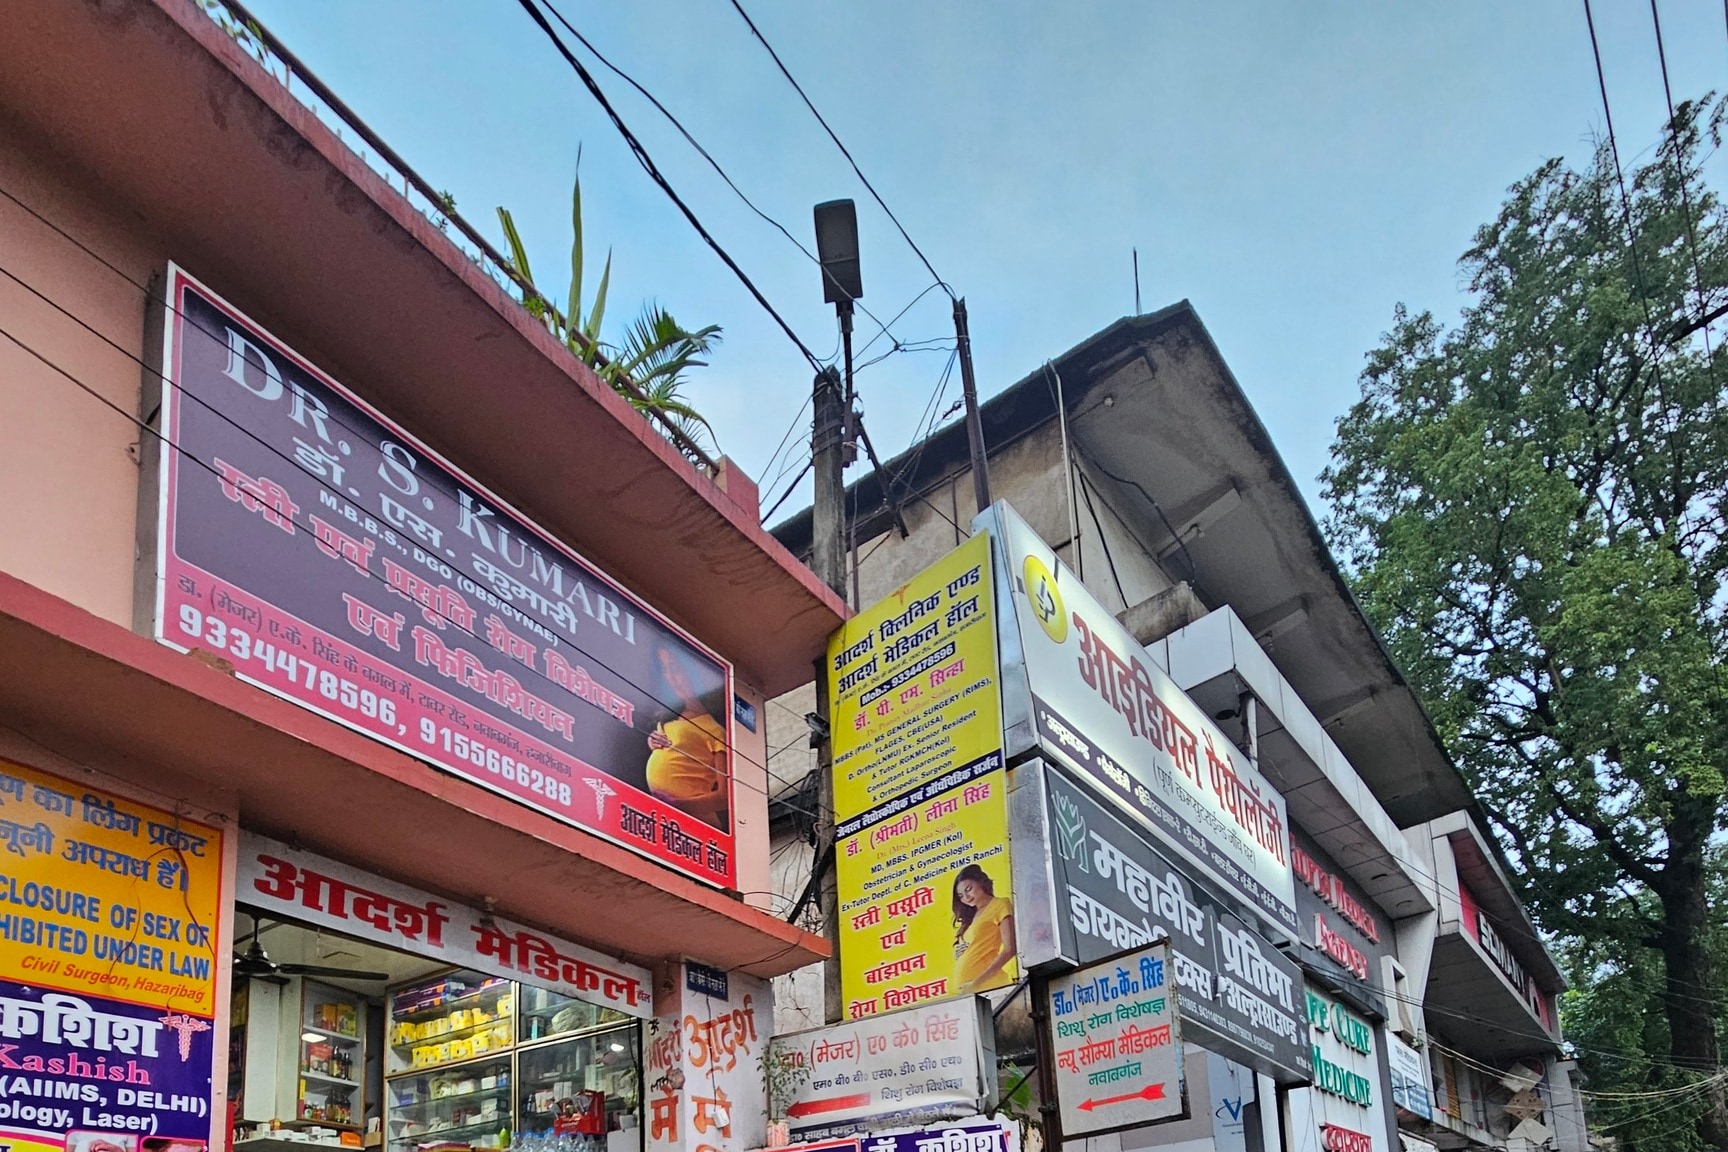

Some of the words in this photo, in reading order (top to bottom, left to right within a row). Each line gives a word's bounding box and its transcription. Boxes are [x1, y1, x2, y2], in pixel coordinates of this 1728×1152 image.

[221, 326, 351, 455] DR.
[378, 440, 434, 510] S.
[456, 488, 636, 645] KUMARI
[292, 437, 360, 497] डॉ.
[379, 492, 455, 557] एस.
[472, 553, 578, 634] कुमारी
[309, 513, 375, 577] एवं
[382, 557, 477, 638] प्रसूति
[484, 614, 537, 670] रोग
[320, 489, 408, 556] M.B.B.S.,
[413, 547, 452, 579] DGO
[457, 575, 559, 646] (OBS/GYNAE)
[342, 593, 405, 652] एवं
[411, 625, 575, 742] फिजिशियन
[834, 629, 874, 671] आदर्श
[838, 654, 878, 695] आदर्श
[883, 618, 940, 664] मेडिकल
[891, 644, 954, 688] 9334478596
[179, 604, 406, 736] 9334478596,
[420, 717, 571, 807] 9155666288
[887, 715, 922, 738] GENERAL
[923, 694, 960, 718] SURGERY
[916, 730, 940, 746] Senior
[942, 710, 977, 735] Resident
[866, 771, 905, 793] Consultant
[906, 745, 957, 775] Laparoscopic
[879, 777, 919, 799] Orthopedic
[921, 760, 953, 781] Surgeon
[33, 784, 75, 817] का
[80, 792, 141, 837] लिंग
[147, 820, 208, 858] प्रकट
[620, 803, 657, 845] आदर्श
[660, 816, 703, 865] मेडिकल
[61, 838, 152, 882] अपराध
[863, 868, 908, 890] Obstetrician
[916, 841, 973, 870] Gynaecologist
[911, 841, 942, 857] IPGMER
[913, 867, 948, 885] Medicine
[973, 844, 1003, 862] Ranchi
[110, 904, 137, 931] OF
[143, 911, 181, 942] SEX
[186, 921, 210, 948] OF
[253, 853, 449, 949] आदर्श
[471, 924, 641, 1008] मेडिकल
[880, 923, 907, 950] एवं
[1089, 829, 1206, 947] महावीर
[1217, 922, 1295, 1013] प्रतिमा
[21, 955, 60, 973] Civil
[63, 963, 130, 990] Surgeon,
[135, 977, 205, 1003] Hazaribag
[93, 933, 164, 972] UNDER
[169, 951, 210, 981] LAW
[1140, 956, 1164, 991] सिंह
[849, 996, 877, 1021] रोग
[1057, 1020, 1086, 1039] शिशु
[1087, 1013, 1112, 1031] रोग
[1115, 997, 1165, 1022] विशेषज्ञ
[1330, 1002, 1372, 1056] CURE
[683, 993, 758, 1073] आदर्श
[1078, 1036, 1116, 1067] सौम्या
[1118, 1024, 1171, 1056] मेडिकल
[1088, 1060, 1142, 1087] नवाबगंज
[1311, 1042, 1373, 1108] MEDICINE
[82, 1107, 158, 1135] Laser)
[117, 1088, 207, 1117] DELHI)
